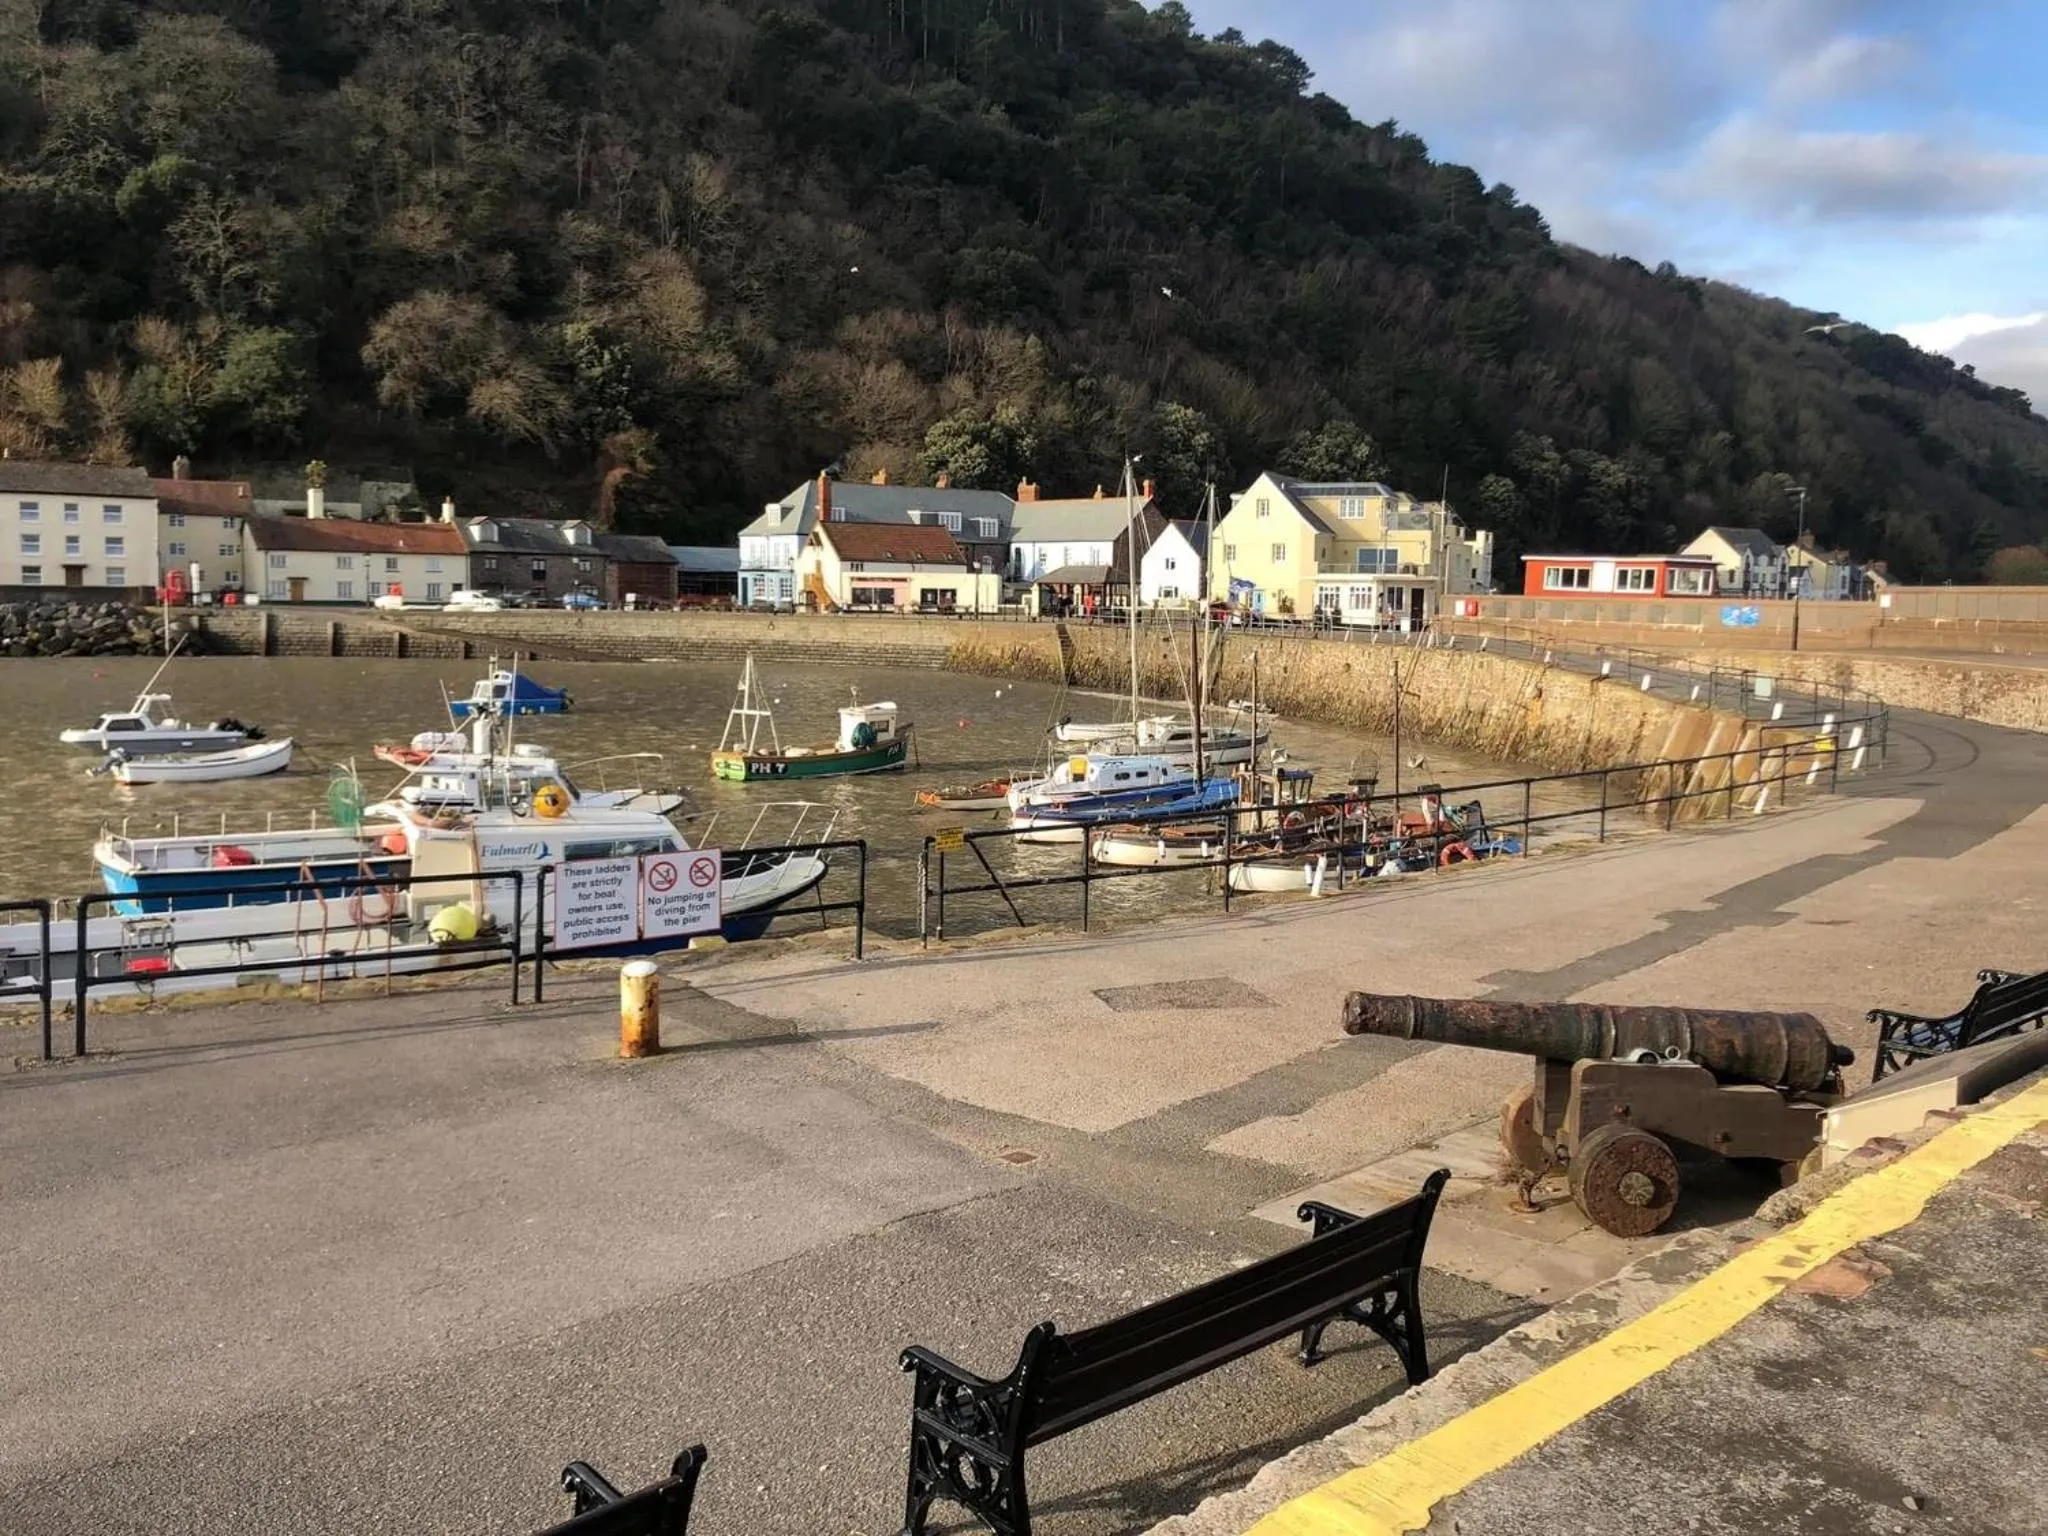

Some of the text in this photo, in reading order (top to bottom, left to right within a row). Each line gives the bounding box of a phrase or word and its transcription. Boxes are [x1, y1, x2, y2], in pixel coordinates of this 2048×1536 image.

[751, 762, 771, 773] PH
[564, 863, 631, 877] These ladders
[572, 876, 623, 890] are strictly
[578, 889, 616, 901] for boat
[648, 889, 717, 907] No jumping or
[568, 904, 603, 915] owners
[655, 901, 711, 917] diving from
[563, 912, 630, 929] public access
[664, 914, 702, 928] the pier
[571, 926, 622, 941] prohibited
